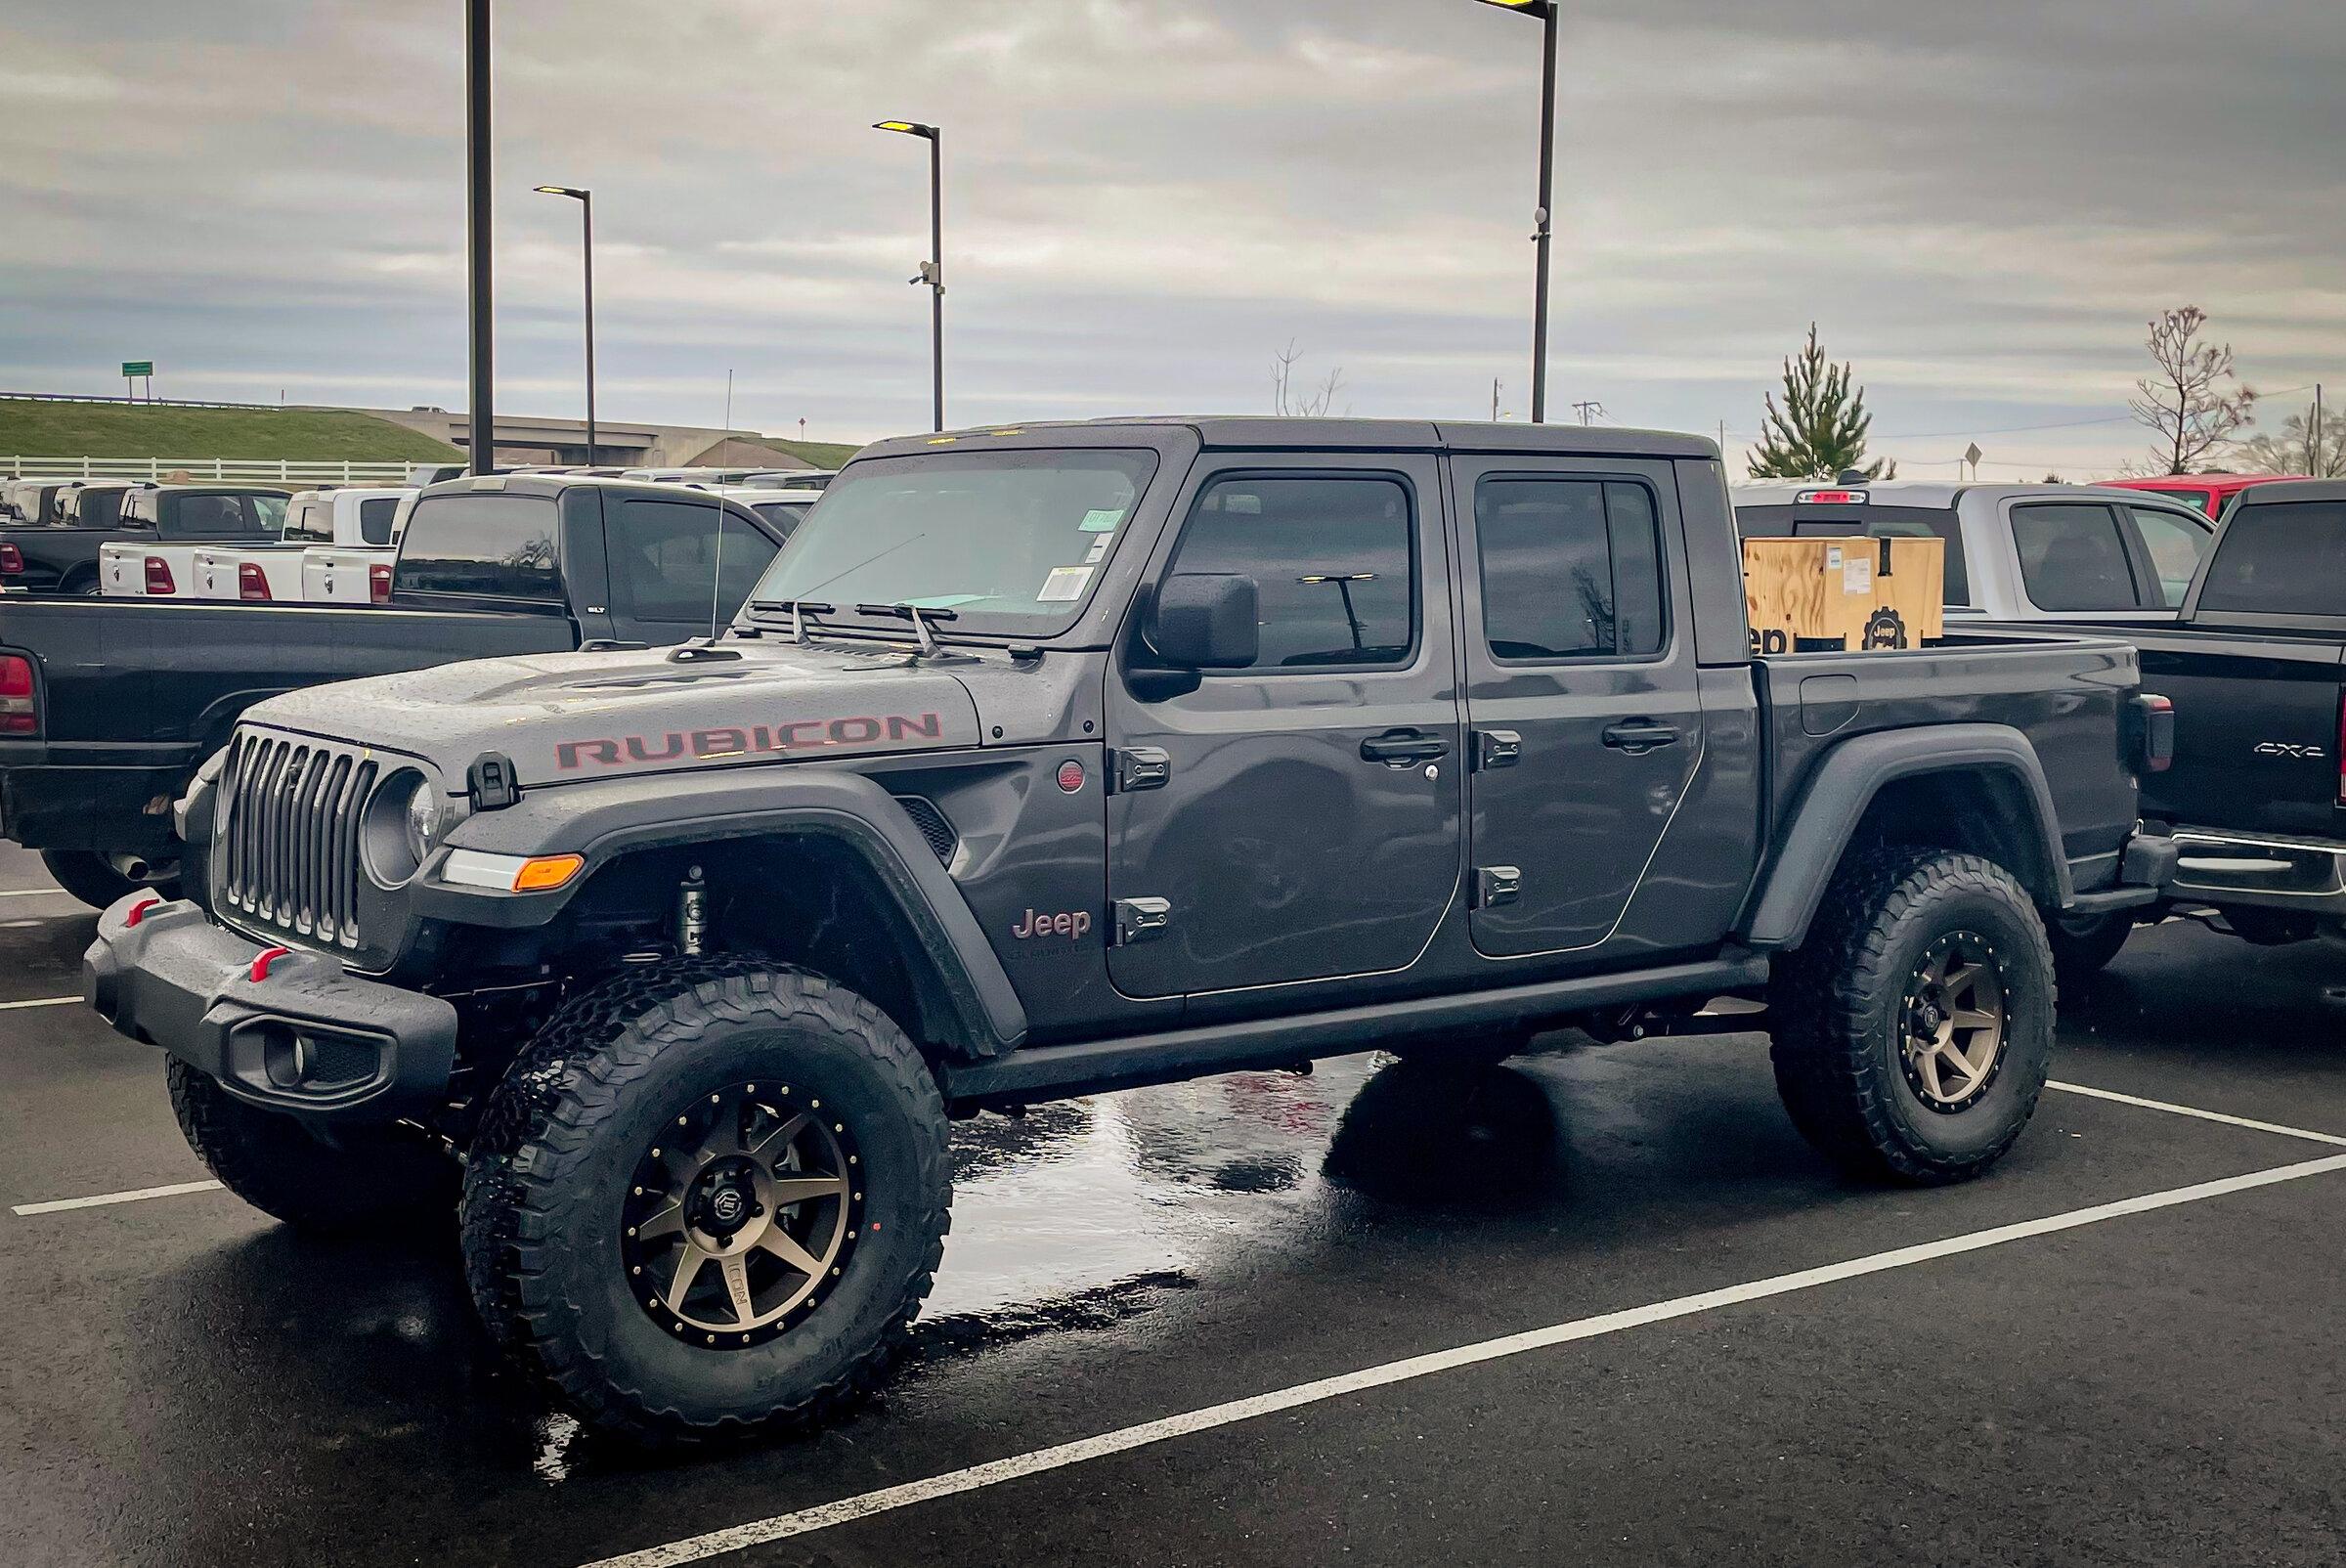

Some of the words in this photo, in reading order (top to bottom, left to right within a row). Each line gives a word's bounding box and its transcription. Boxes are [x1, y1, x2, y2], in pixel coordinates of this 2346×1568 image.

[1874, 626, 1895, 639] Jeep
[555, 712, 942, 770] RUBICON
[1012, 908, 1091, 940] Jeep
[728, 1263, 747, 1305] ICON
